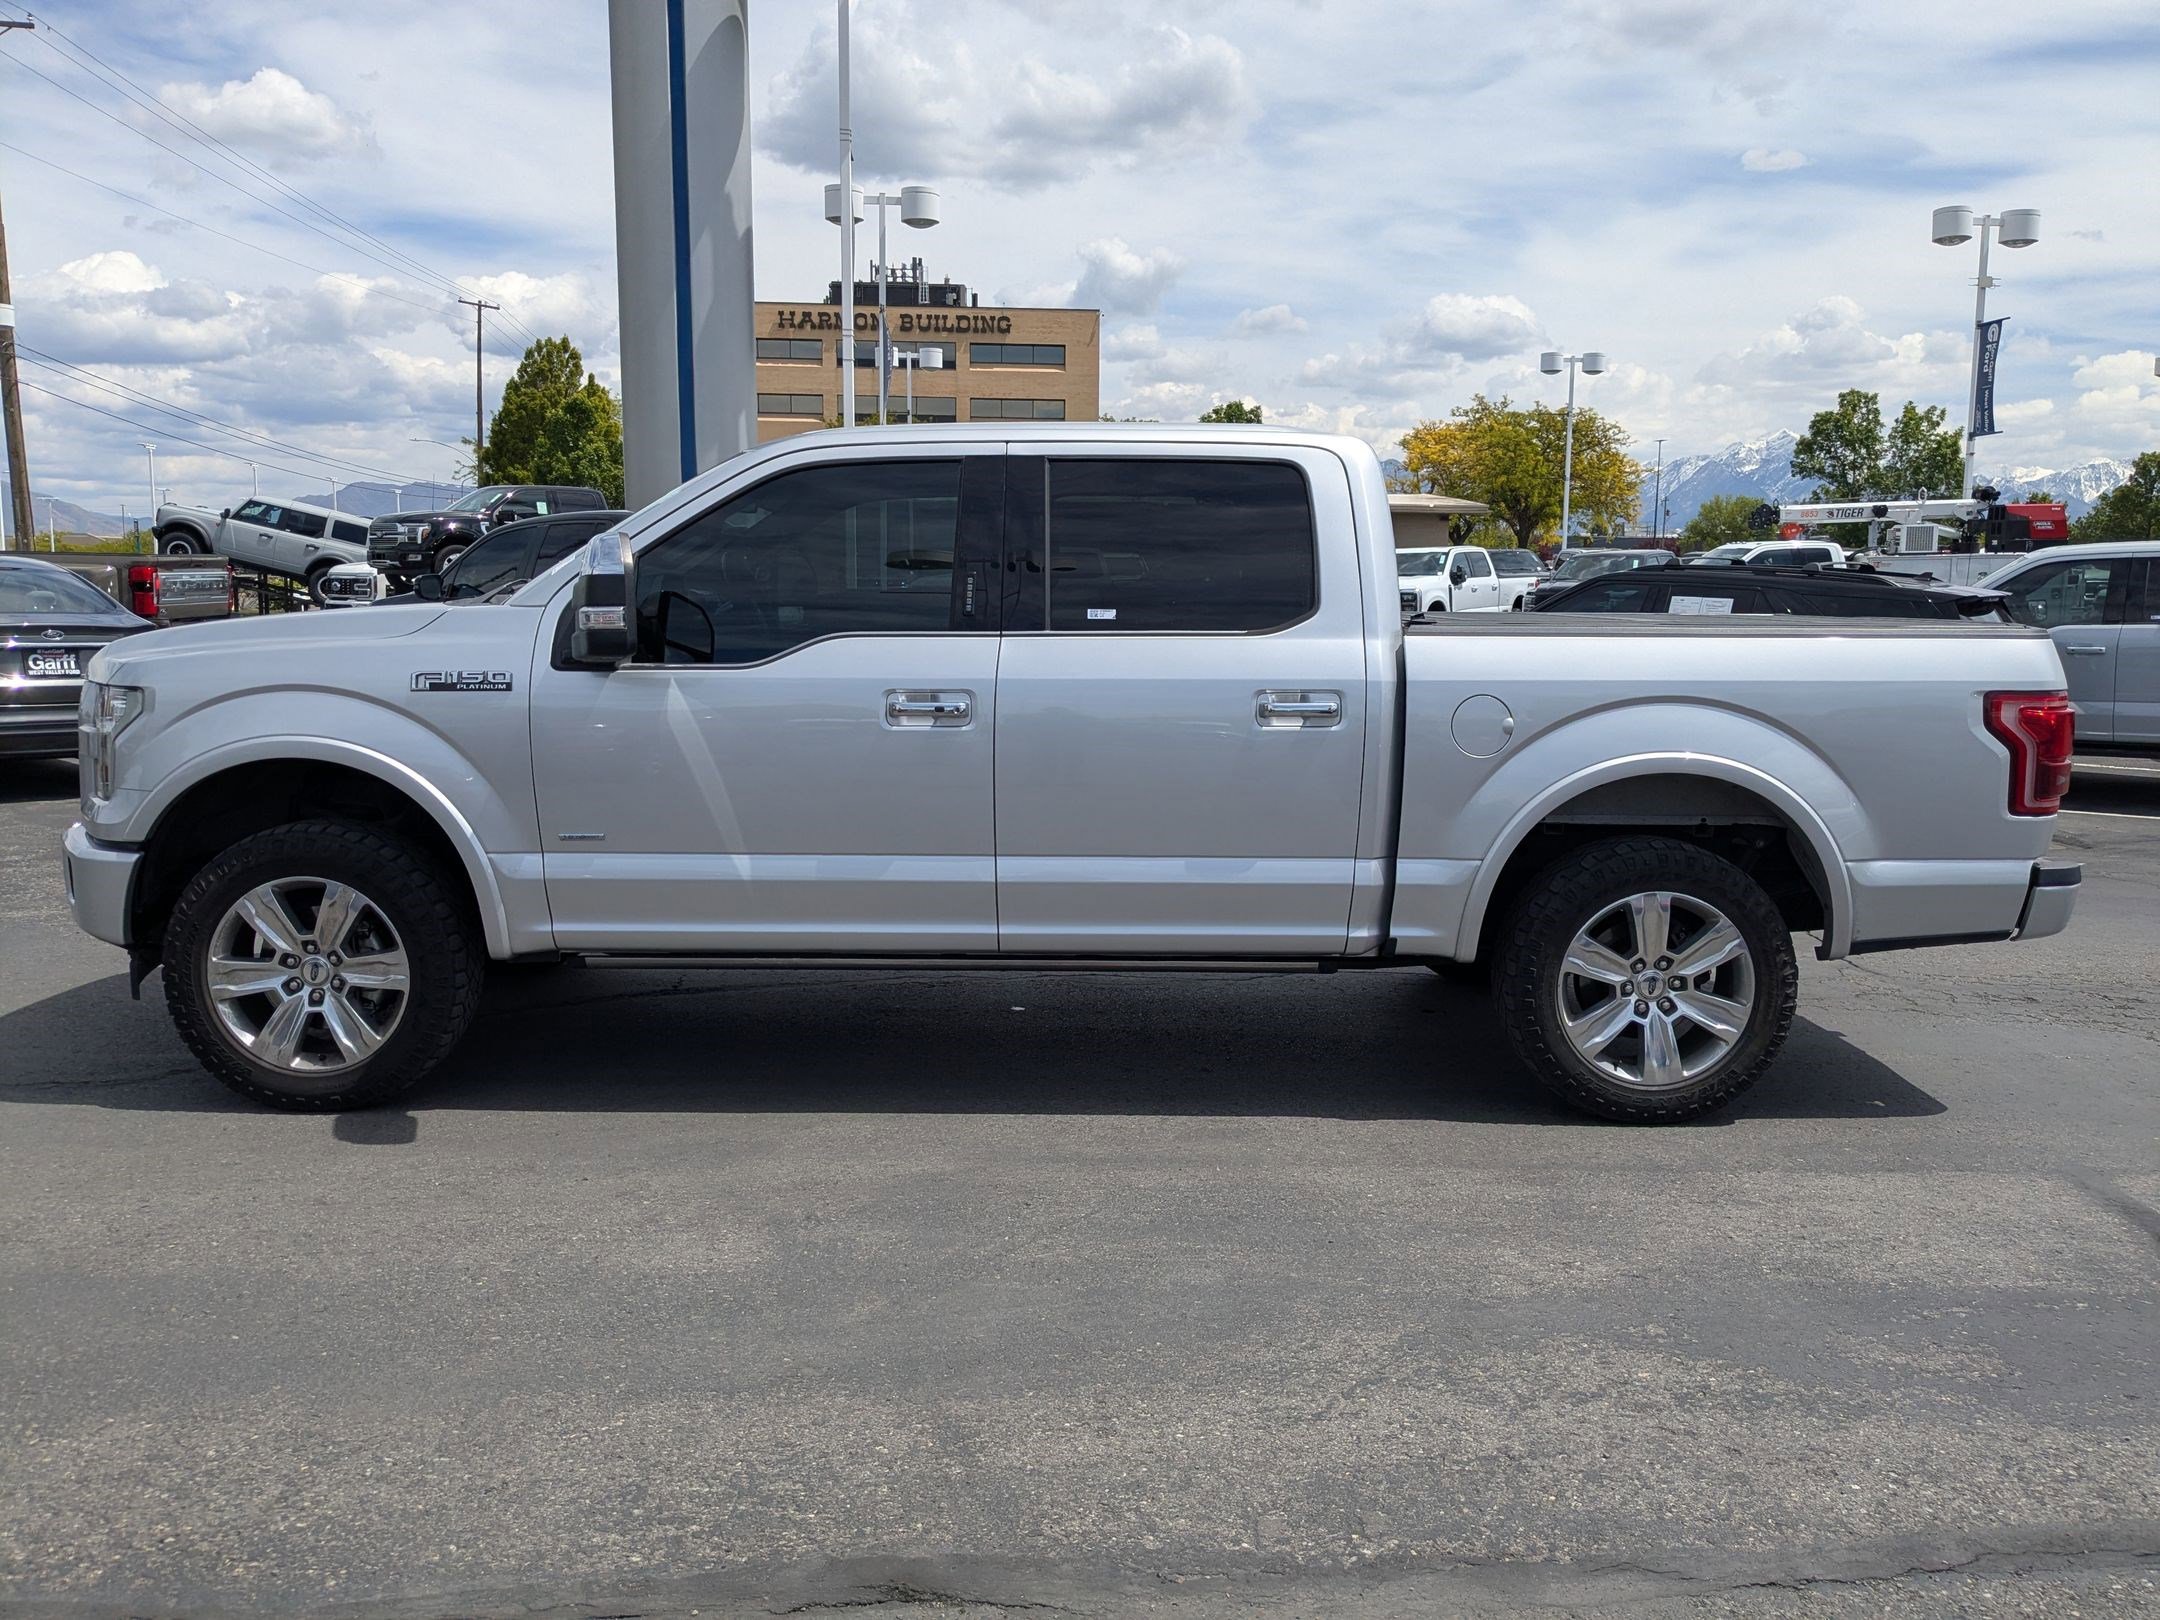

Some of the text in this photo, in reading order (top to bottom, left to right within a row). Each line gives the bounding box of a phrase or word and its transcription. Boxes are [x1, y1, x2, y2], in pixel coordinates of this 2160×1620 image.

[899, 313, 1012, 334] BUILDING
[1983, 344, 1993, 373] Ford
[1835, 507, 1865, 518] TIGER
[28, 653, 76, 670] Garff
